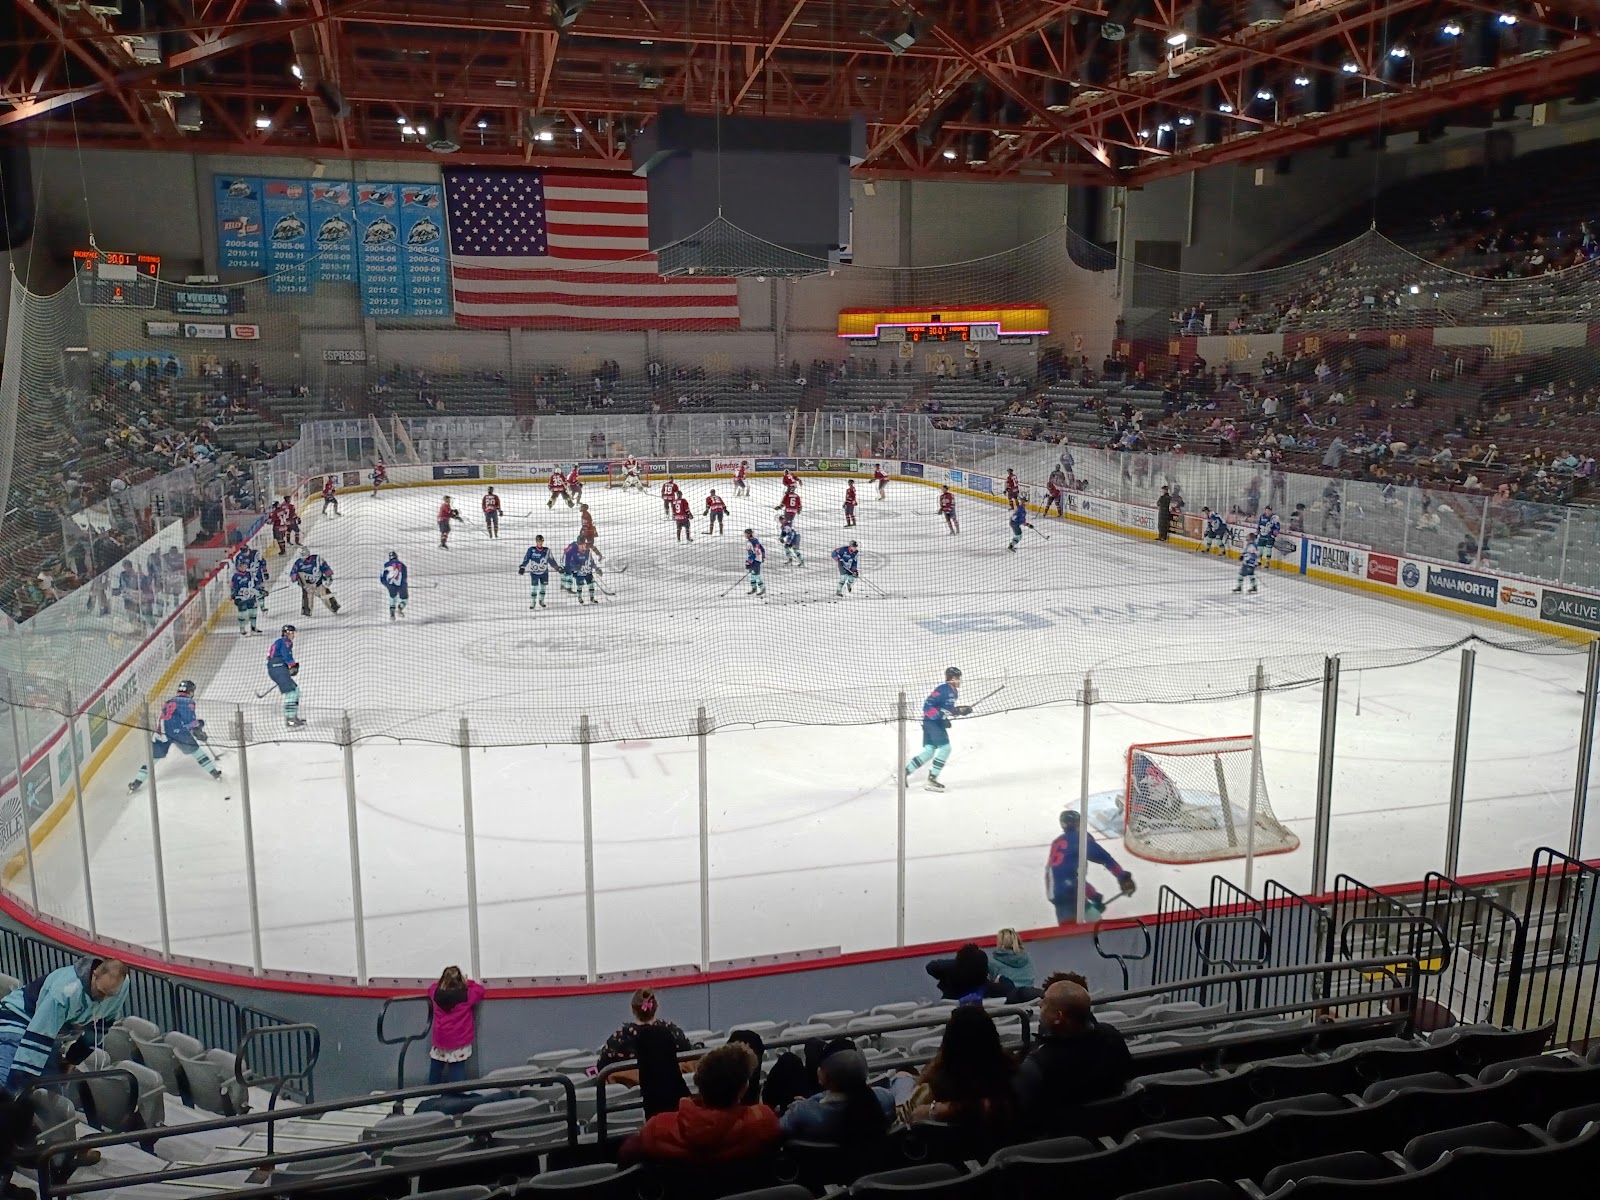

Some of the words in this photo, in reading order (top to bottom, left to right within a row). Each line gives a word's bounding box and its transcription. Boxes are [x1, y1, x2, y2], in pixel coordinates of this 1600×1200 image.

[226, 239, 259, 248] 2005-06
[272, 242, 305, 250] 2005-06
[227, 249, 258, 257] 2010-11
[365, 244, 397, 253] 2004-05
[228, 259, 260, 268] 2013-14
[150, 264, 156, 274] 0
[321, 273, 351, 281] 2013-14
[411, 275, 440, 283] 2010-11
[971, 325, 997, 338] ADN
[913, 333, 919, 341] 0
[962, 332, 967, 341] 0
[322, 350, 367, 361] ESPRESSO
[789, 498, 796, 506] 6
[1321, 546, 1350, 565] DALTON
[1557, 599, 1573, 613] AK
[1574, 603, 1597, 619] LIVE
